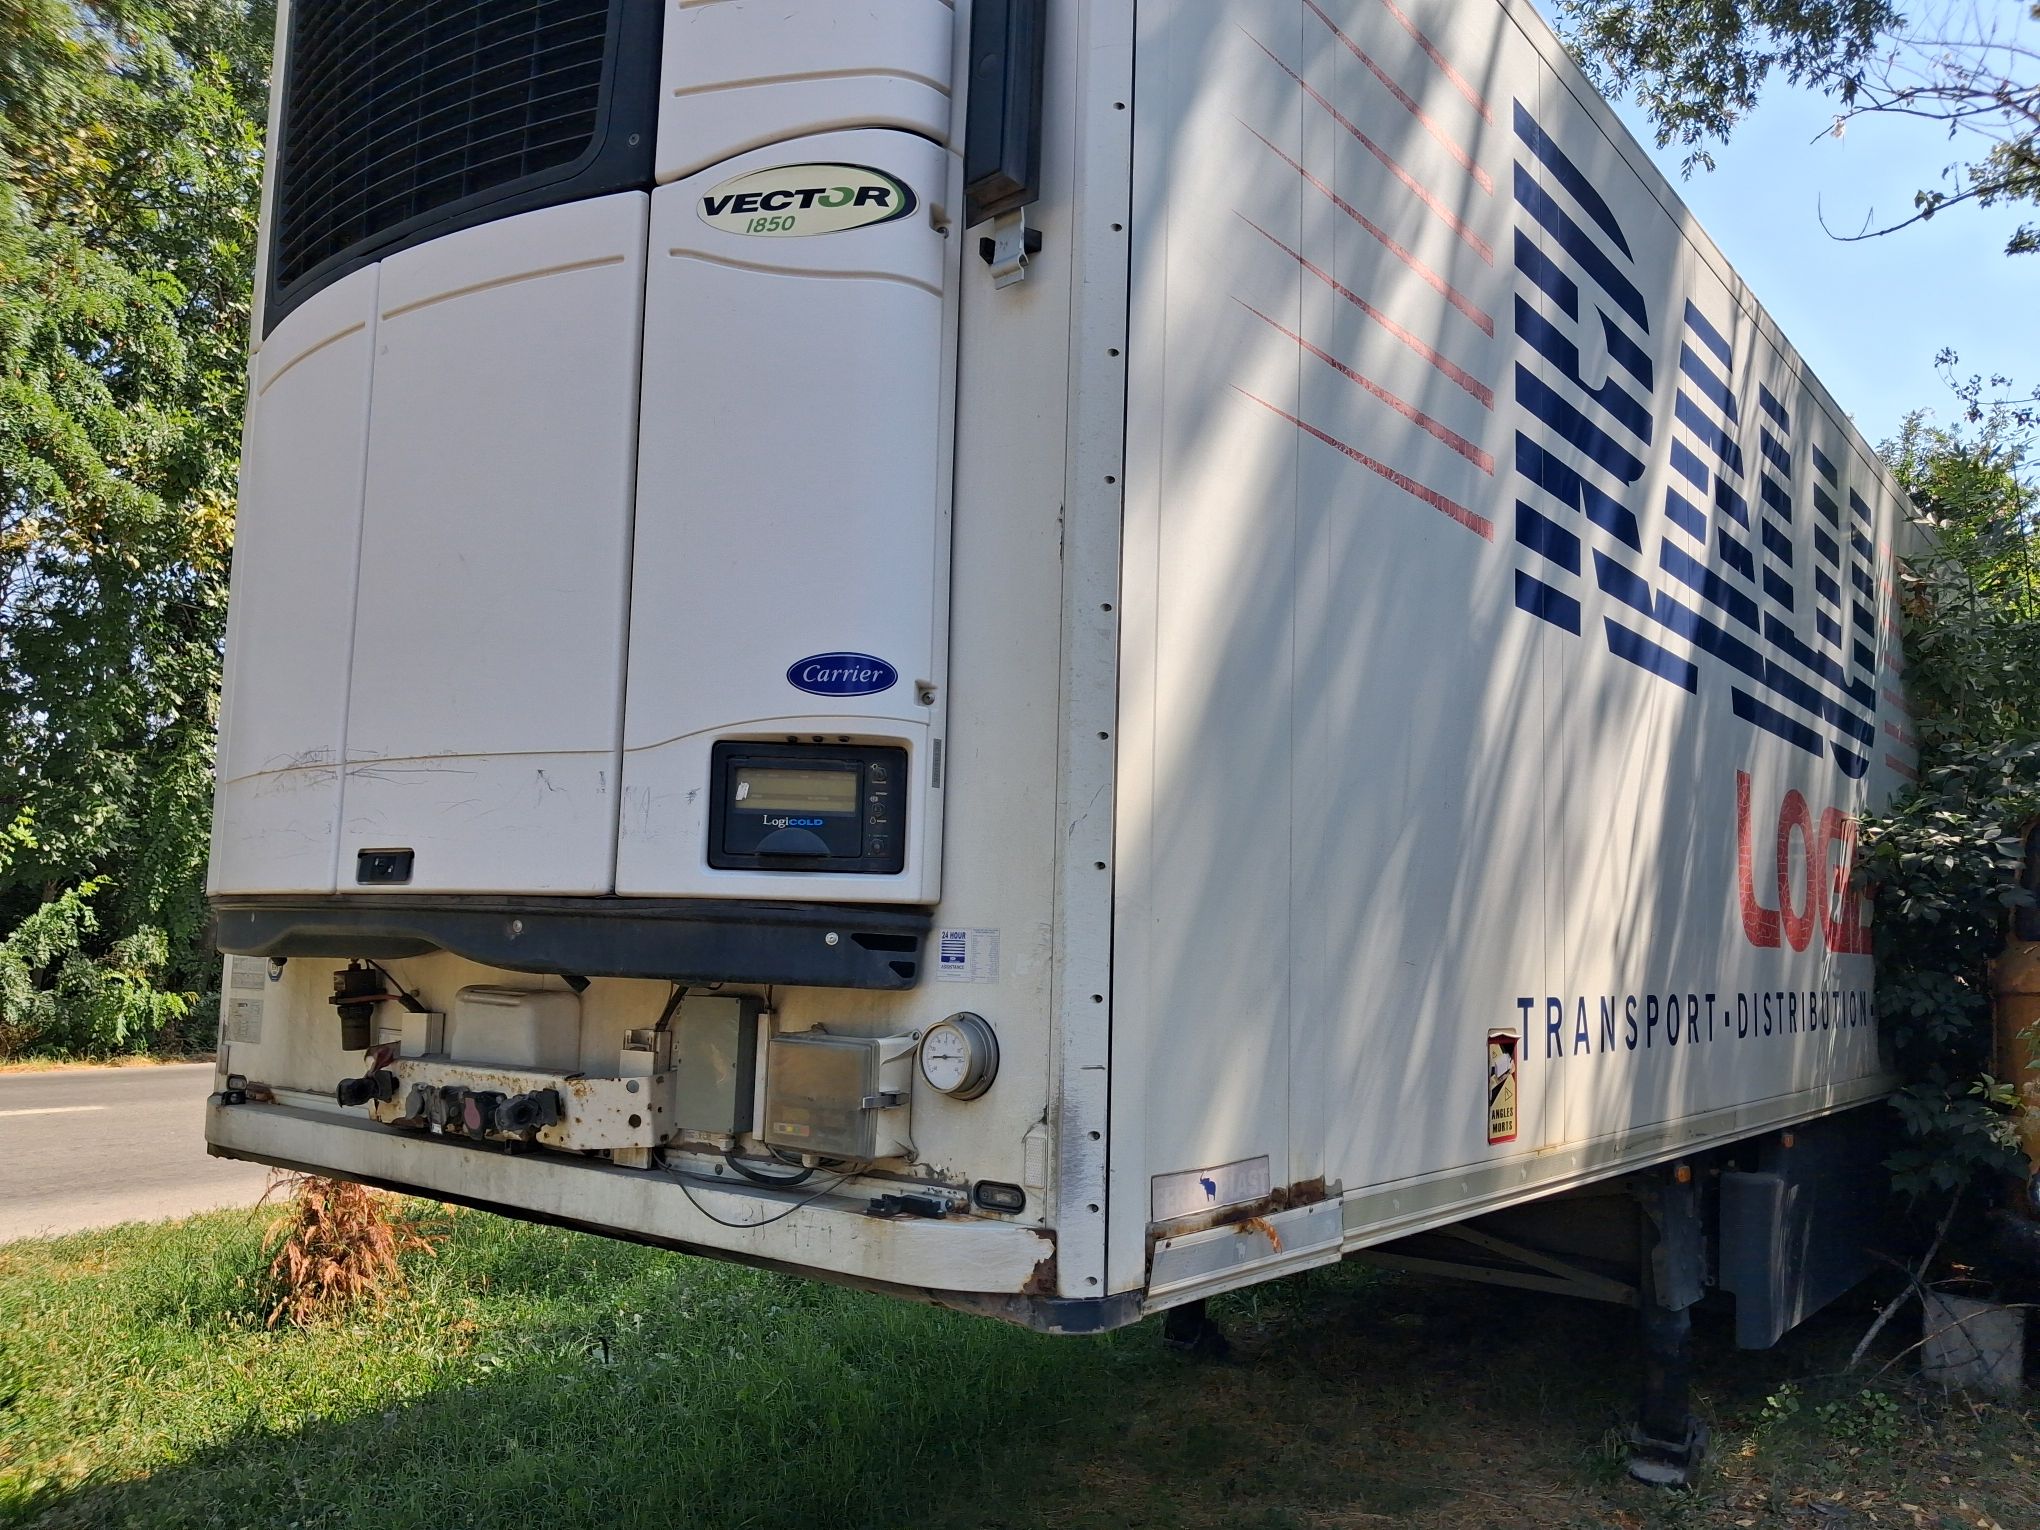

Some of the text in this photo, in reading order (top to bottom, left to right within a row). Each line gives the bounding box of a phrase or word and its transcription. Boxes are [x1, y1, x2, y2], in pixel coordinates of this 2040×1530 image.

[703, 186, 891, 216] VECTOR
[746, 215, 796, 234] 1850
[803, 664, 883, 683] Carrier
[941, 931, 966, 940] 24 HOUR
[1517, 991, 1867, 1061] TRANSPORT DISTRIBUTION
[1491, 1107, 1514, 1120] ANGLES
[1492, 1120, 1513, 1134] MORTS
